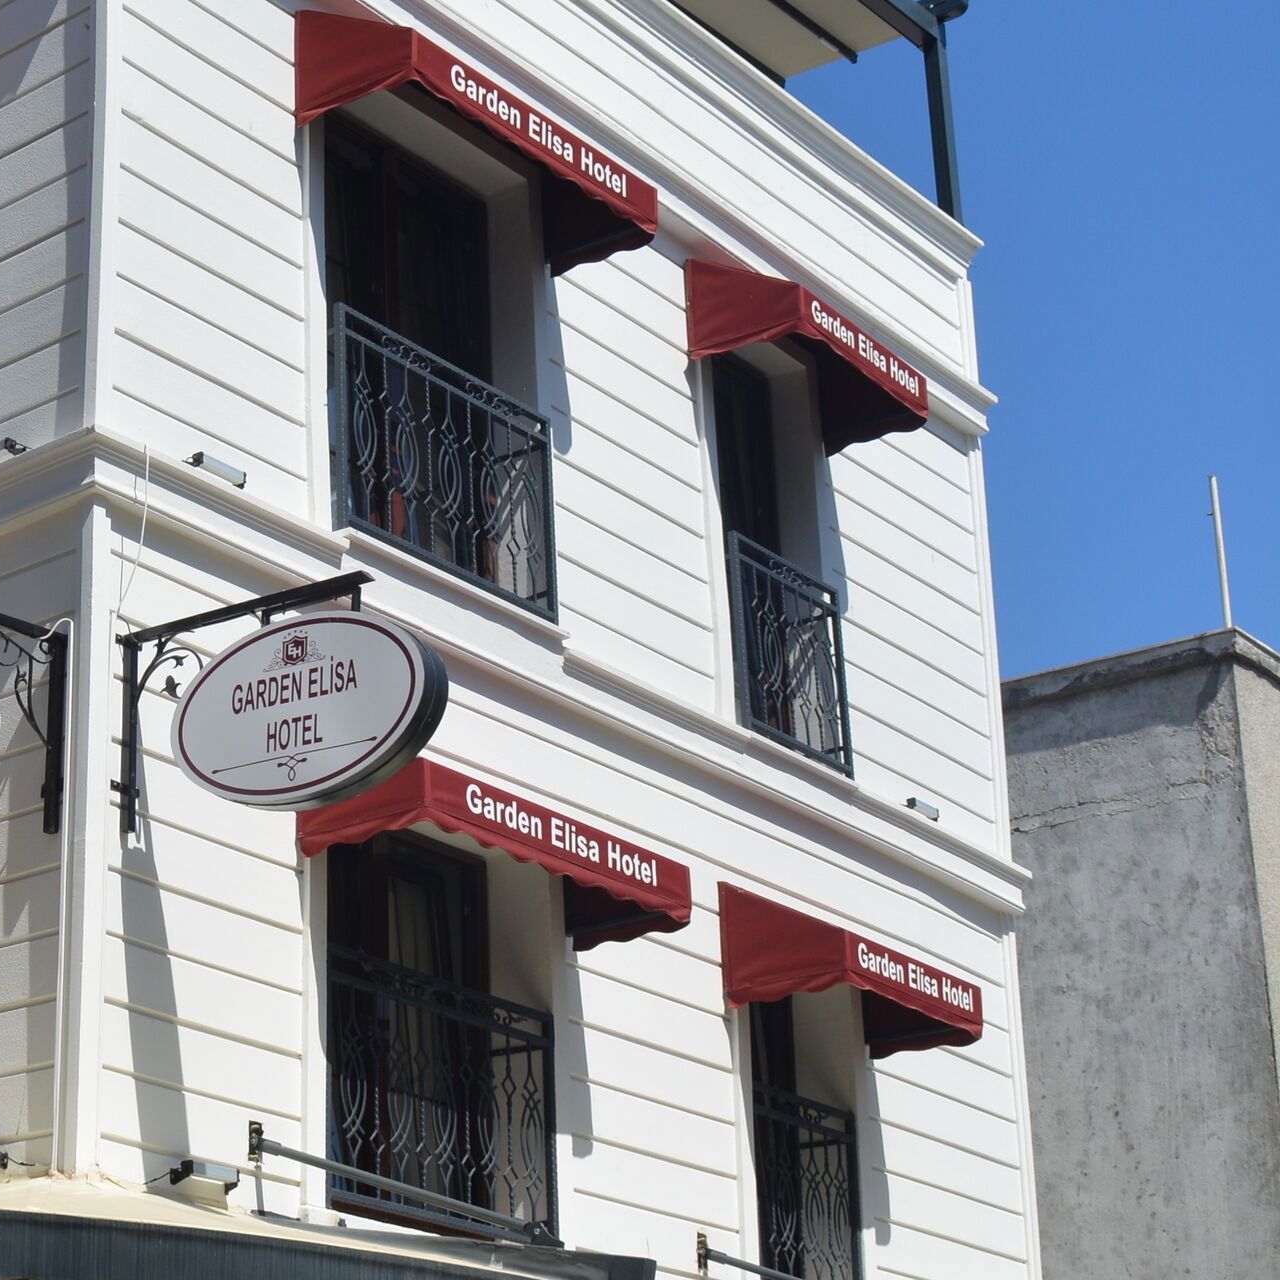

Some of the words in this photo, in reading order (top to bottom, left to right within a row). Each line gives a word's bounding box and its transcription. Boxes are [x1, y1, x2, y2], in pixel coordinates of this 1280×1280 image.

[450, 64, 521, 129] Garden
[528, 112, 574, 164] Elisa
[581, 147, 627, 198] Hotel
[811, 300, 855, 349] Garden
[858, 333, 887, 373] Elisa
[890, 357, 919, 397] Hotel
[231, 671, 303, 714] GARDEN
[308, 655, 358, 699] ELİSA
[266, 713, 323, 753] HOTEL
[465, 783, 543, 840] Garden
[550, 816, 600, 864] Elisa
[607, 840, 658, 887] Hotel
[857, 942, 905, 984] Garden
[907, 962, 939, 998] Elisa
[942, 976, 973, 1012] Hotel
